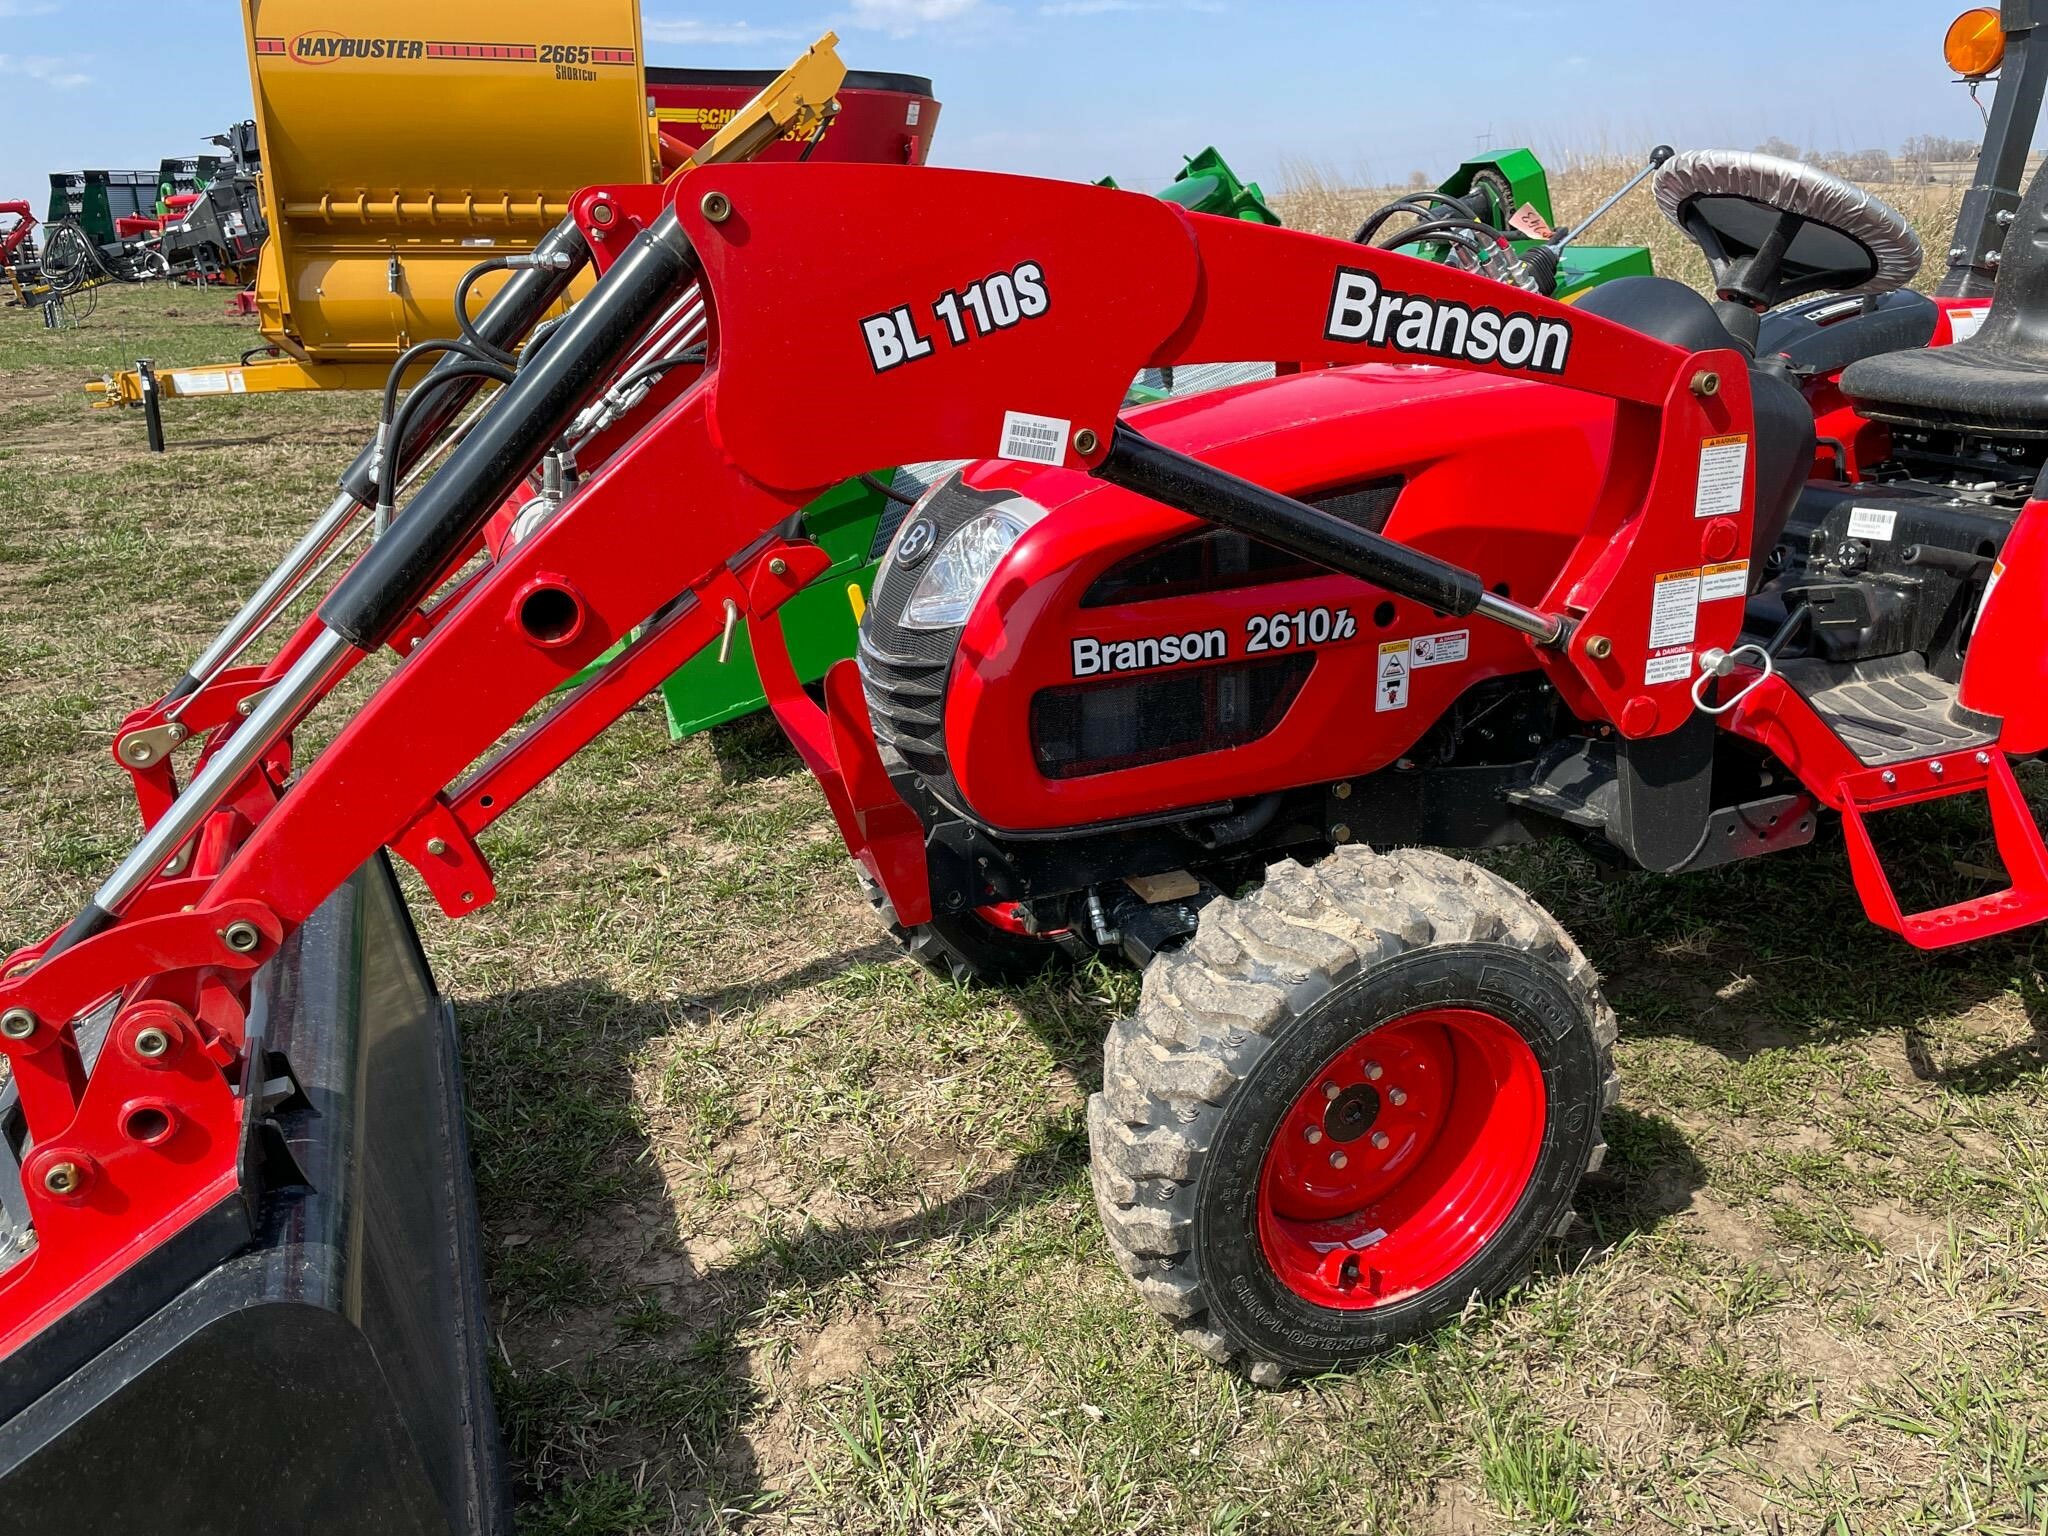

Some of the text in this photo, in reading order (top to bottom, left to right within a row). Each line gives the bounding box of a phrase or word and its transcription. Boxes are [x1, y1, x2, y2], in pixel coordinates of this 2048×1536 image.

[297, 37, 424, 59] HAYBUSTER
[539, 44, 590, 64] 2665
[555, 64, 597, 82] SHORTCUT
[861, 261, 1049, 372] BL 110S
[1326, 268, 1571, 373] Branson
[1715, 437, 1742, 446] WARNING
[1669, 570, 1695, 579] WARNING
[1716, 563, 1742, 573] WARNING
[1073, 608, 1356, 676] Branson 2610h
[1662, 646, 1687, 656] DANGER
